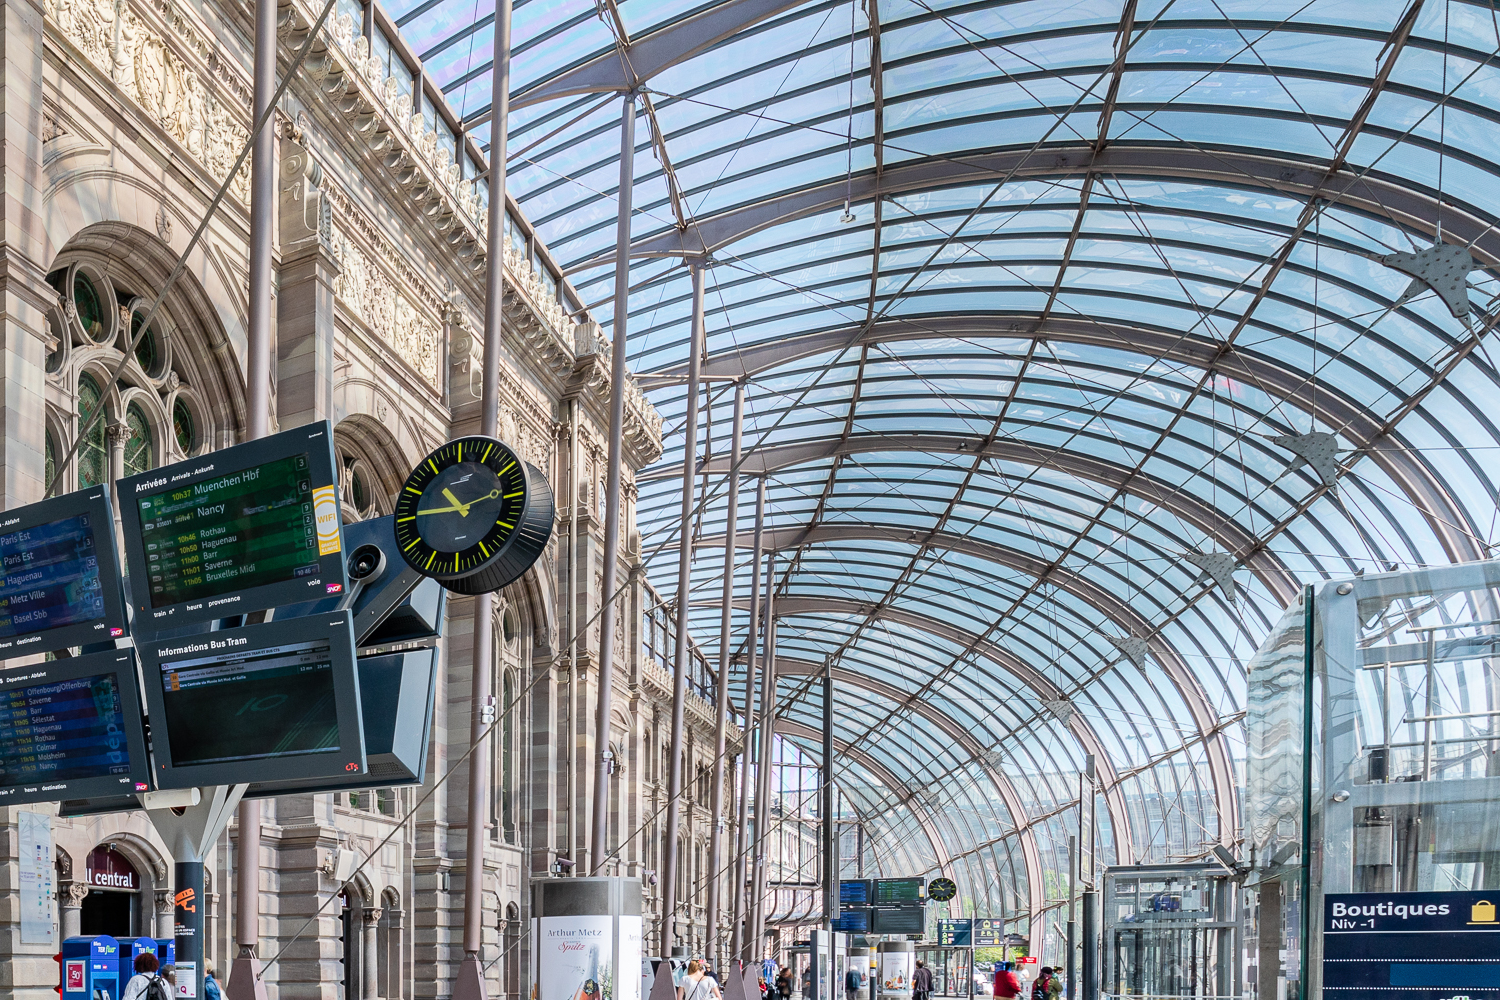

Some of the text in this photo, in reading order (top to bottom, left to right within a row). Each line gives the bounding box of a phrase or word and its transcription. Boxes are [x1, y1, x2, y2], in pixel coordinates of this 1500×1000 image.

[136, 464, 214, 492] Arrivées Arrivals Ankunft
[172, 490, 192, 501] 10h37
[194, 476, 240, 496] Muenchen
[242, 468, 260, 482] Hbf
[197, 504, 226, 518] Nancy
[317, 514, 336, 526] WIFI
[0, 534, 18, 546] Paris
[19, 532, 30, 541] Est
[178, 534, 196, 544] 10h46
[200, 526, 226, 538] Rothau
[202, 535, 238, 550] Haguenau
[4, 555, 21, 566] Paris
[22, 552, 34, 561] Est
[203, 552, 218, 560] Barr
[204, 559, 232, 571] Saverne
[7, 571, 42, 585] Haguenau
[206, 568, 238, 582] Bruxelles
[240, 564, 256, 574] Midi
[10, 594, 28, 604] Metz
[30, 590, 46, 600] Ville
[186, 602, 202, 611] heure
[208, 596, 240, 608] provenance
[307, 578, 320, 586] voie
[13, 614, 32, 624] Basel
[34, 610, 48, 620] Sbb
[17, 636, 42, 646] destination
[158, 636, 247, 657] Informations Bus Tram
[29, 696, 51, 706] Saverne
[32, 715, 55, 724] Sélestat
[33, 724, 62, 735] Haguenau
[35, 734, 55, 743] Rothau
[36, 743, 57, 752] Colmar
[38, 751, 66, 761] Molsheim
[39, 762, 58, 771] Nancy
[42, 783, 67, 791] destination
[95, 872, 133, 887] central
[1332, 902, 1450, 920] Boutiques
[1332, 919, 1375, 929] Niv -1
